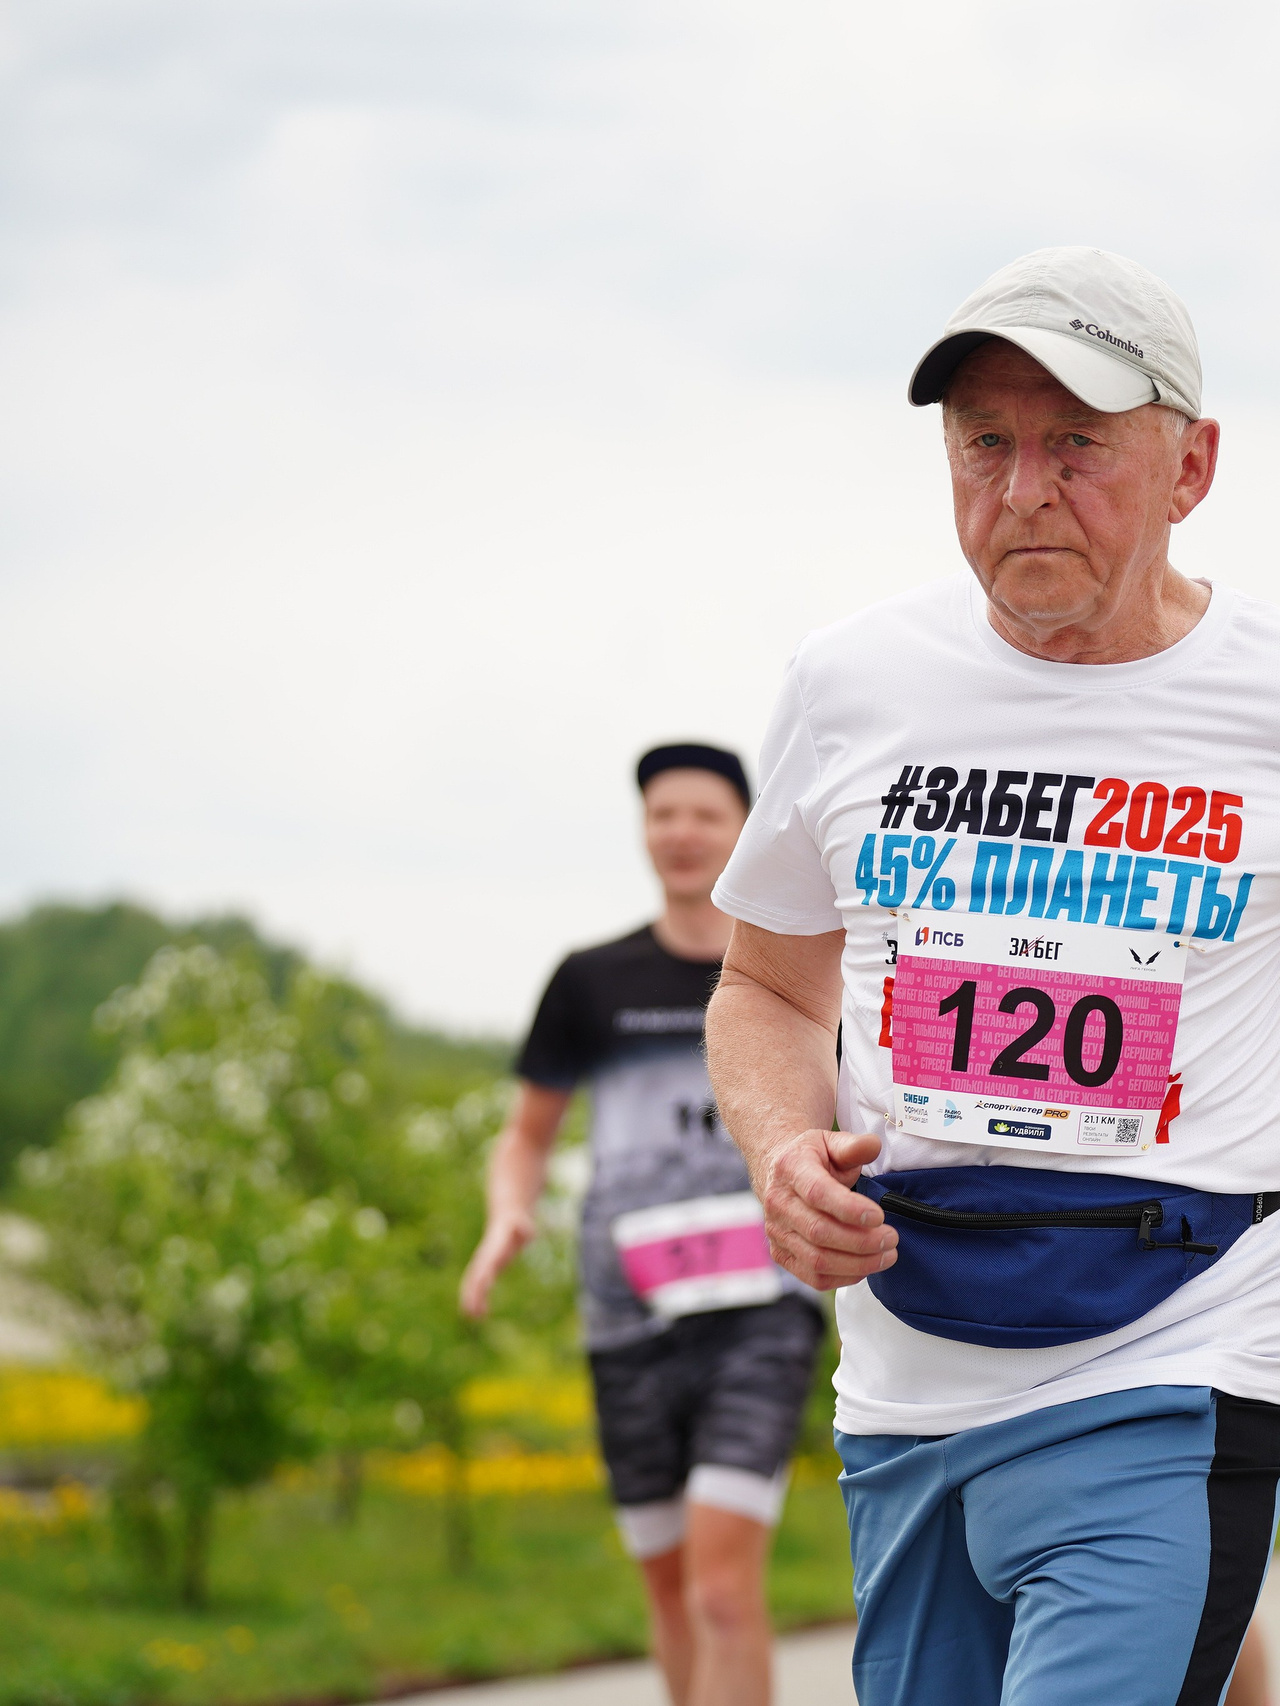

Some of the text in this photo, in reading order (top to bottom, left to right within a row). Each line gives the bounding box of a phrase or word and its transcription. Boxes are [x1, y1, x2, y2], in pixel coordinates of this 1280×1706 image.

[1085, 323, 1144, 359] Columbia
[880, 765, 1243, 863] #ЗАБЕГ2025
[855, 833, 1256, 942] 45% ПЛАНЕТЫ
[932, 931, 964, 947] ПСБ
[923, 974, 933, 987] НА
[943, 959, 953, 972] ЗА
[953, 960, 982, 975] РАМКИ
[997, 965, 1036, 981] БЕГОВАЯ
[1037, 969, 1103, 988] ПЕРЕЗАГРУЗКА
[1120, 978, 1154, 992] СТРЕСС
[923, 990, 940, 1003] СЕБЕ
[1138, 1013, 1161, 1027] СПЯТ
[1005, 1015, 1017, 1029] ЗА
[939, 980, 1123, 1088] 120
[981, 1030, 993, 1044] НА
[1124, 1046, 1162, 1061] СЕРДЦЕМ
[920, 1056, 945, 1071] СТРЕСС
[1128, 1078, 1163, 1092] БЕГОВАЯ
[934, 1042, 948, 1055] БЕГ
[1135, 1063, 1157, 1076] ПОКА
[903, 1093, 929, 1105] СИБУР
[950, 1077, 983, 1093] ТОЛЬКО
[984, 1081, 1019, 1097] НАЧАЛО
[1033, 1086, 1045, 1100] НА
[1046, 1088, 1080, 1103] СТАРТЕ
[1080, 1092, 1113, 1106] ЖИЗНИ
[1126, 1095, 1146, 1108] БЕГУ
[1044, 1110, 1068, 1118] PRO
[1084, 1115, 1099, 1124] 21.1
